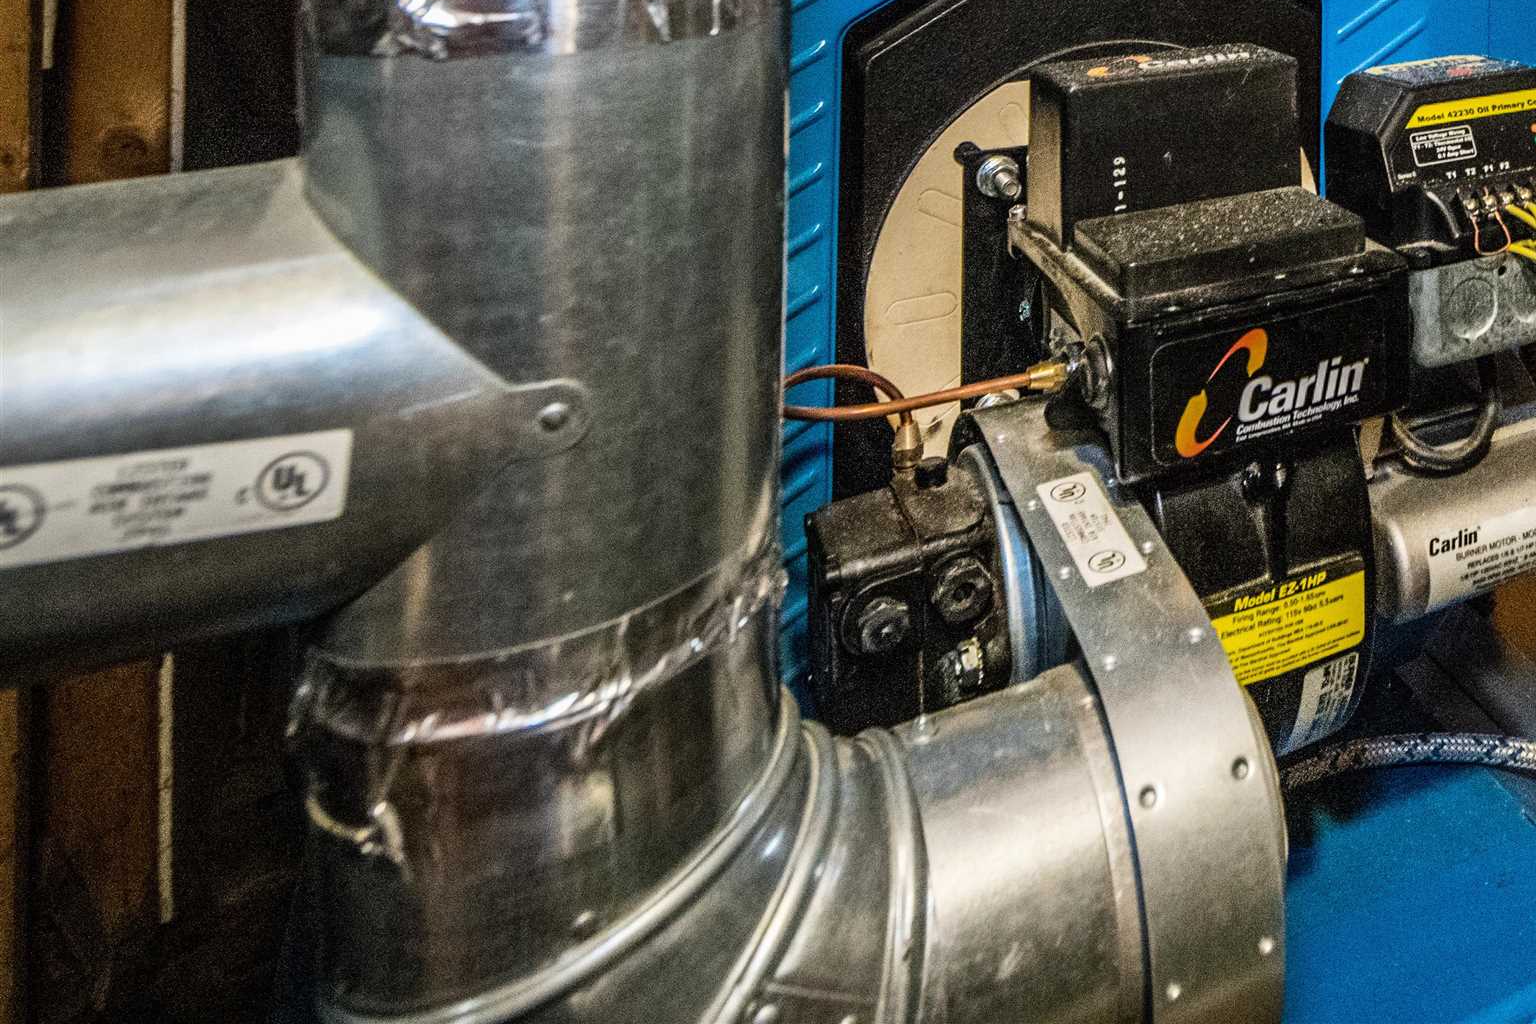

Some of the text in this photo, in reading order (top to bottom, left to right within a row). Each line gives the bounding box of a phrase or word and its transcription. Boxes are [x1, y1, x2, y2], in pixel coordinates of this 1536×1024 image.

[1417, 113, 1445, 123] Model
[1477, 105, 1490, 114] Oil
[1491, 101, 1525, 113] Primary
[1113, 156, 1127, 212] 1-129
[1446, 171, 1457, 179] T1
[1237, 355, 1366, 423] Carlin
[1236, 394, 1360, 435] Combustion Technology, Inc.
[1429, 527, 1479, 556] Carlin
[1456, 544, 1487, 561] BURNER
[1489, 535, 1517, 550] MOTOR
[1234, 570, 1327, 612] Model EZ-1HP
[1221, 622, 1256, 640] Electrical
[1232, 613, 1254, 624] Firing
